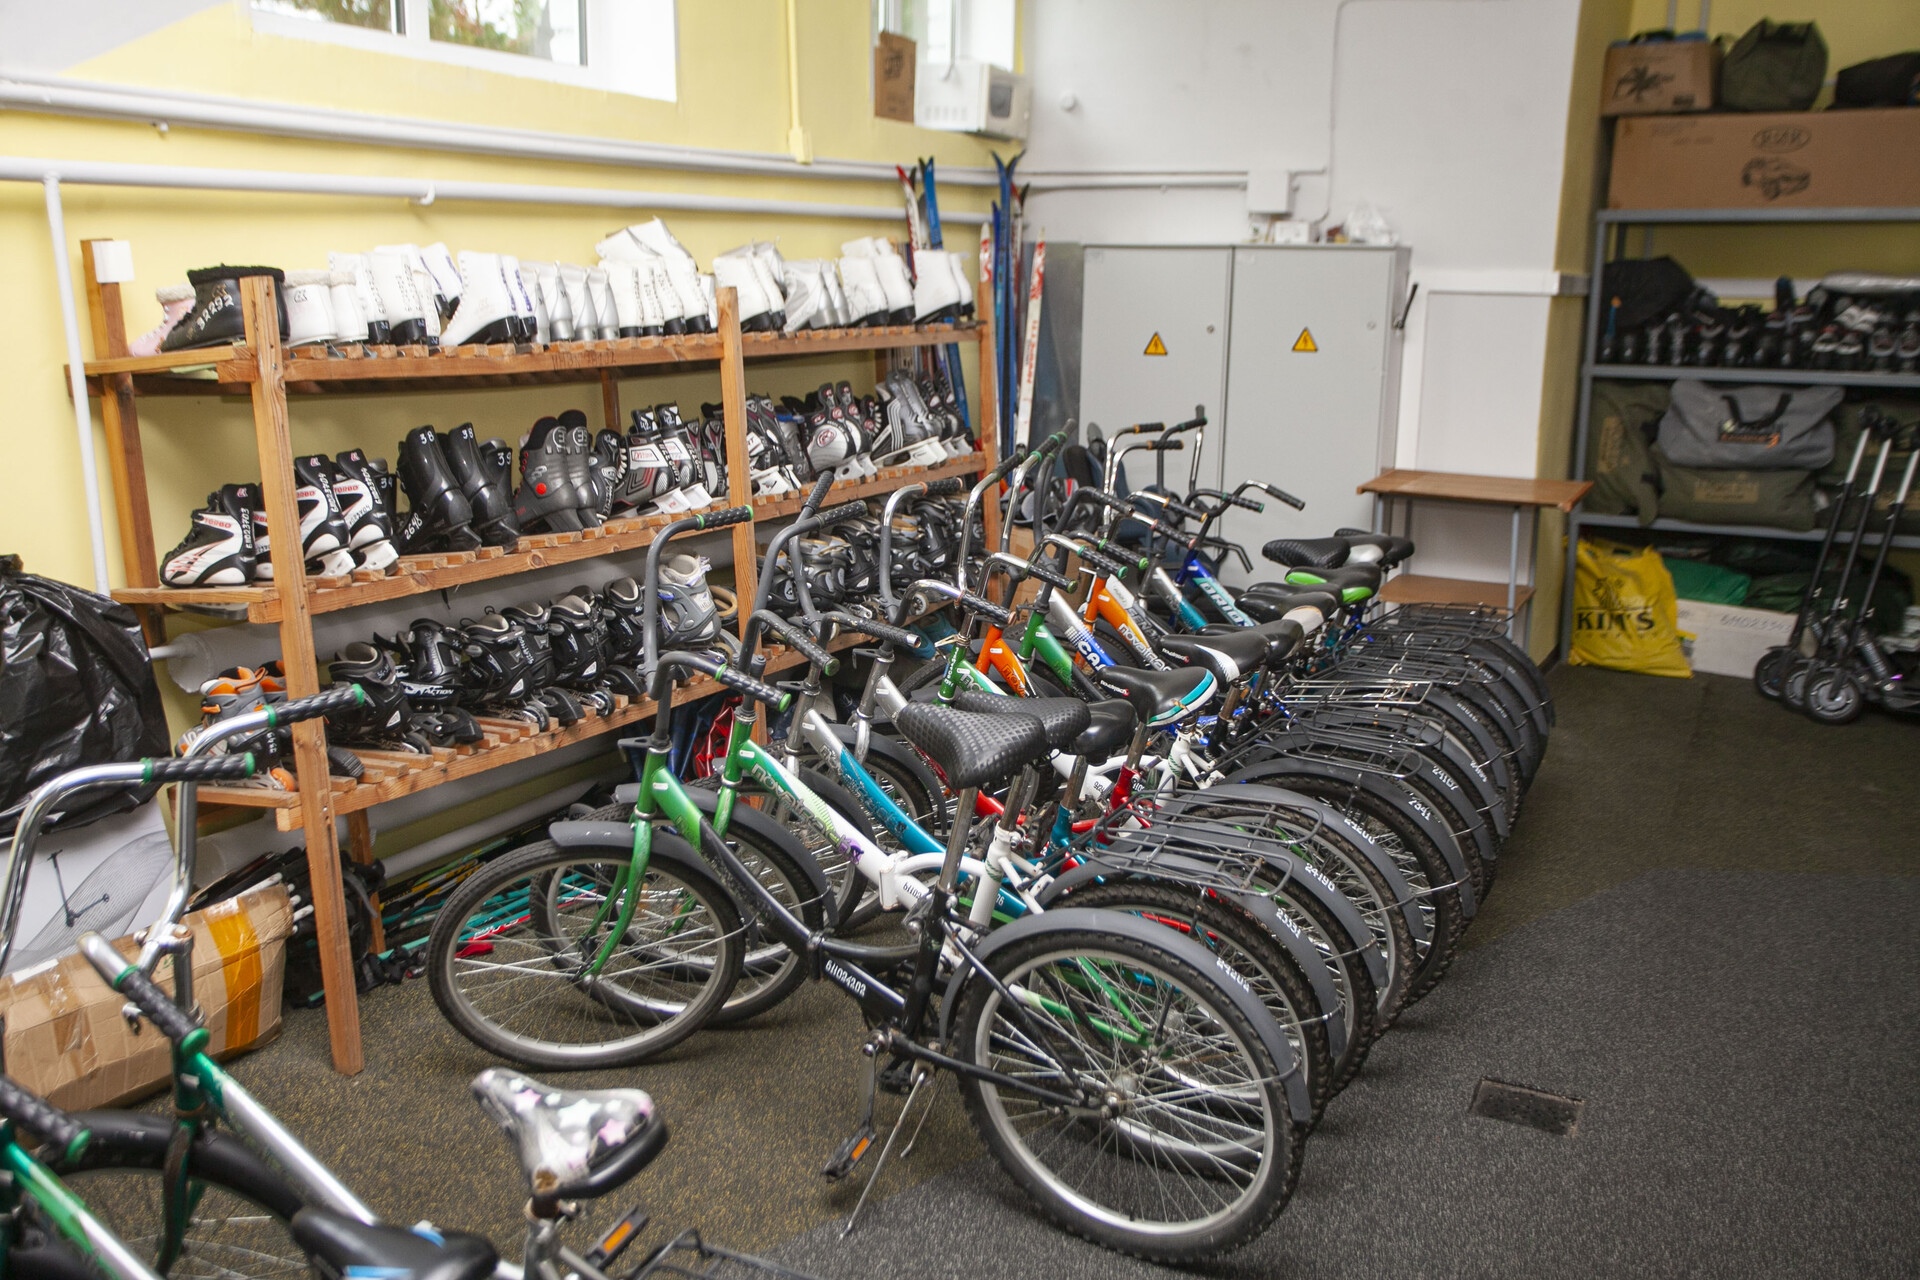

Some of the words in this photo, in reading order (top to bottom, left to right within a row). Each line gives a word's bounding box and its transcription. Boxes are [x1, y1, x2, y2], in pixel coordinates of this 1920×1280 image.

[419, 430, 435, 445] 38
[461, 427, 474, 440] 38
[404, 512, 423, 540] 2648
[423, 687, 455, 697] ACTION
